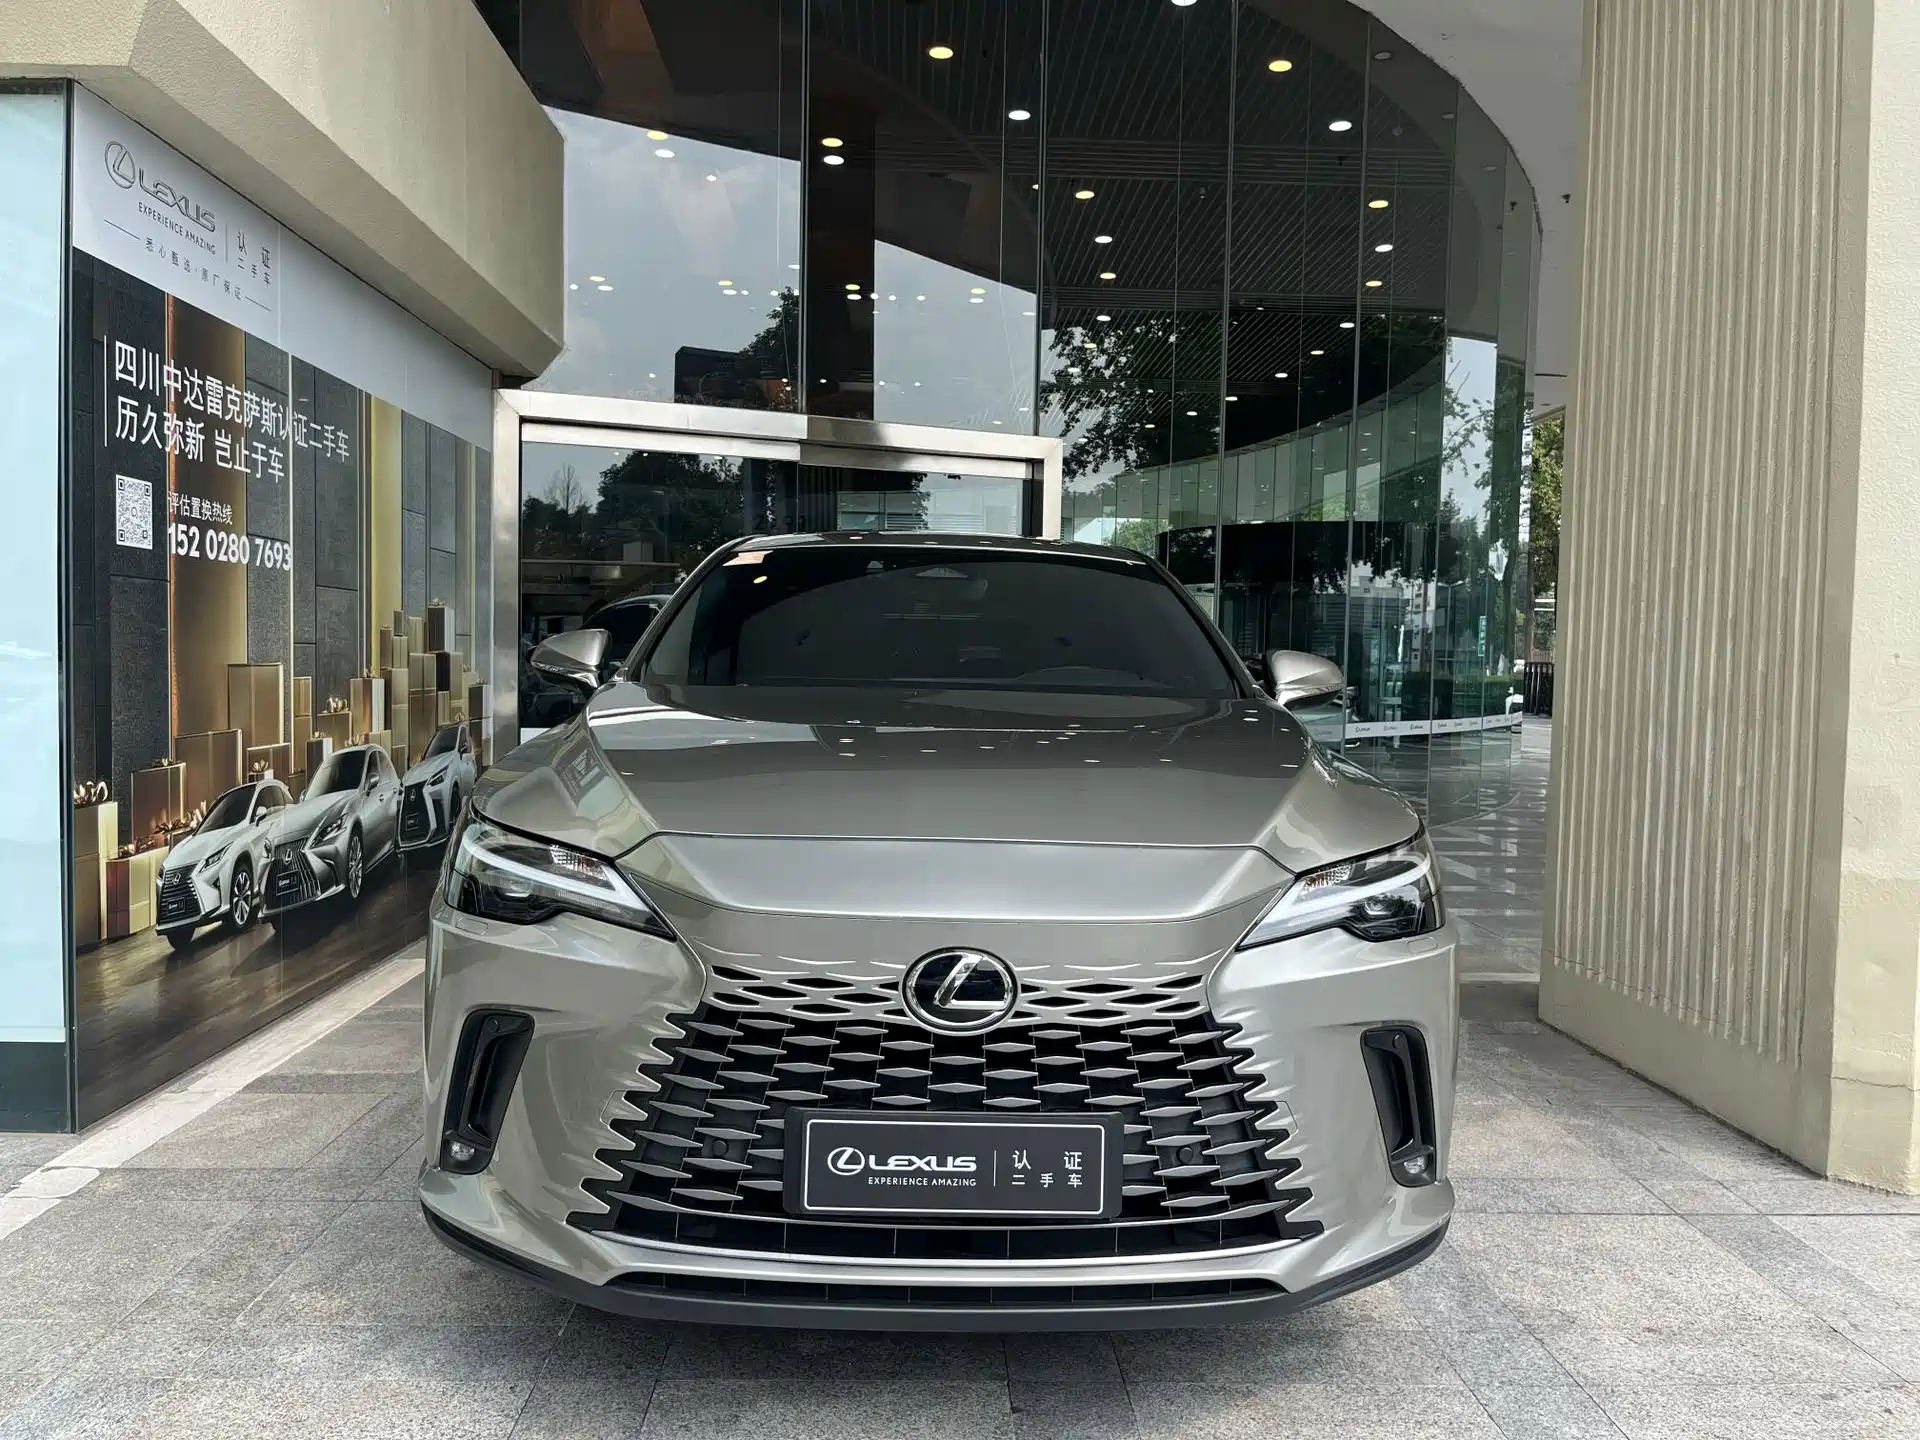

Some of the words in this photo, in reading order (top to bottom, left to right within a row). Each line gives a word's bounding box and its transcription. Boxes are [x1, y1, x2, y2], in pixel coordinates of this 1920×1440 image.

[138, 167, 216, 232] LEXUS
[138, 201, 183, 236] EXPERIENCE
[185, 230, 216, 255] AMAZING
[115, 340, 350, 463] 四川中达雷克萨斯认证二手车
[115, 395, 206, 463] 历久弥新
[214, 428, 285, 484] 岂止于车
[168, 491, 233, 526] 评估置换热线
[168, 522, 200, 559] 152
[205, 528, 250, 565] 0280
[254, 537, 292, 571] 7693
[868, 1154, 977, 1172] LEXUS
[1011, 1172, 1083, 1188] 二手车
[1012, 1149, 1083, 1171] 认证
[868, 1176, 929, 1187] EXPERIENCE
[931, 1178, 977, 1188] AMAZING
